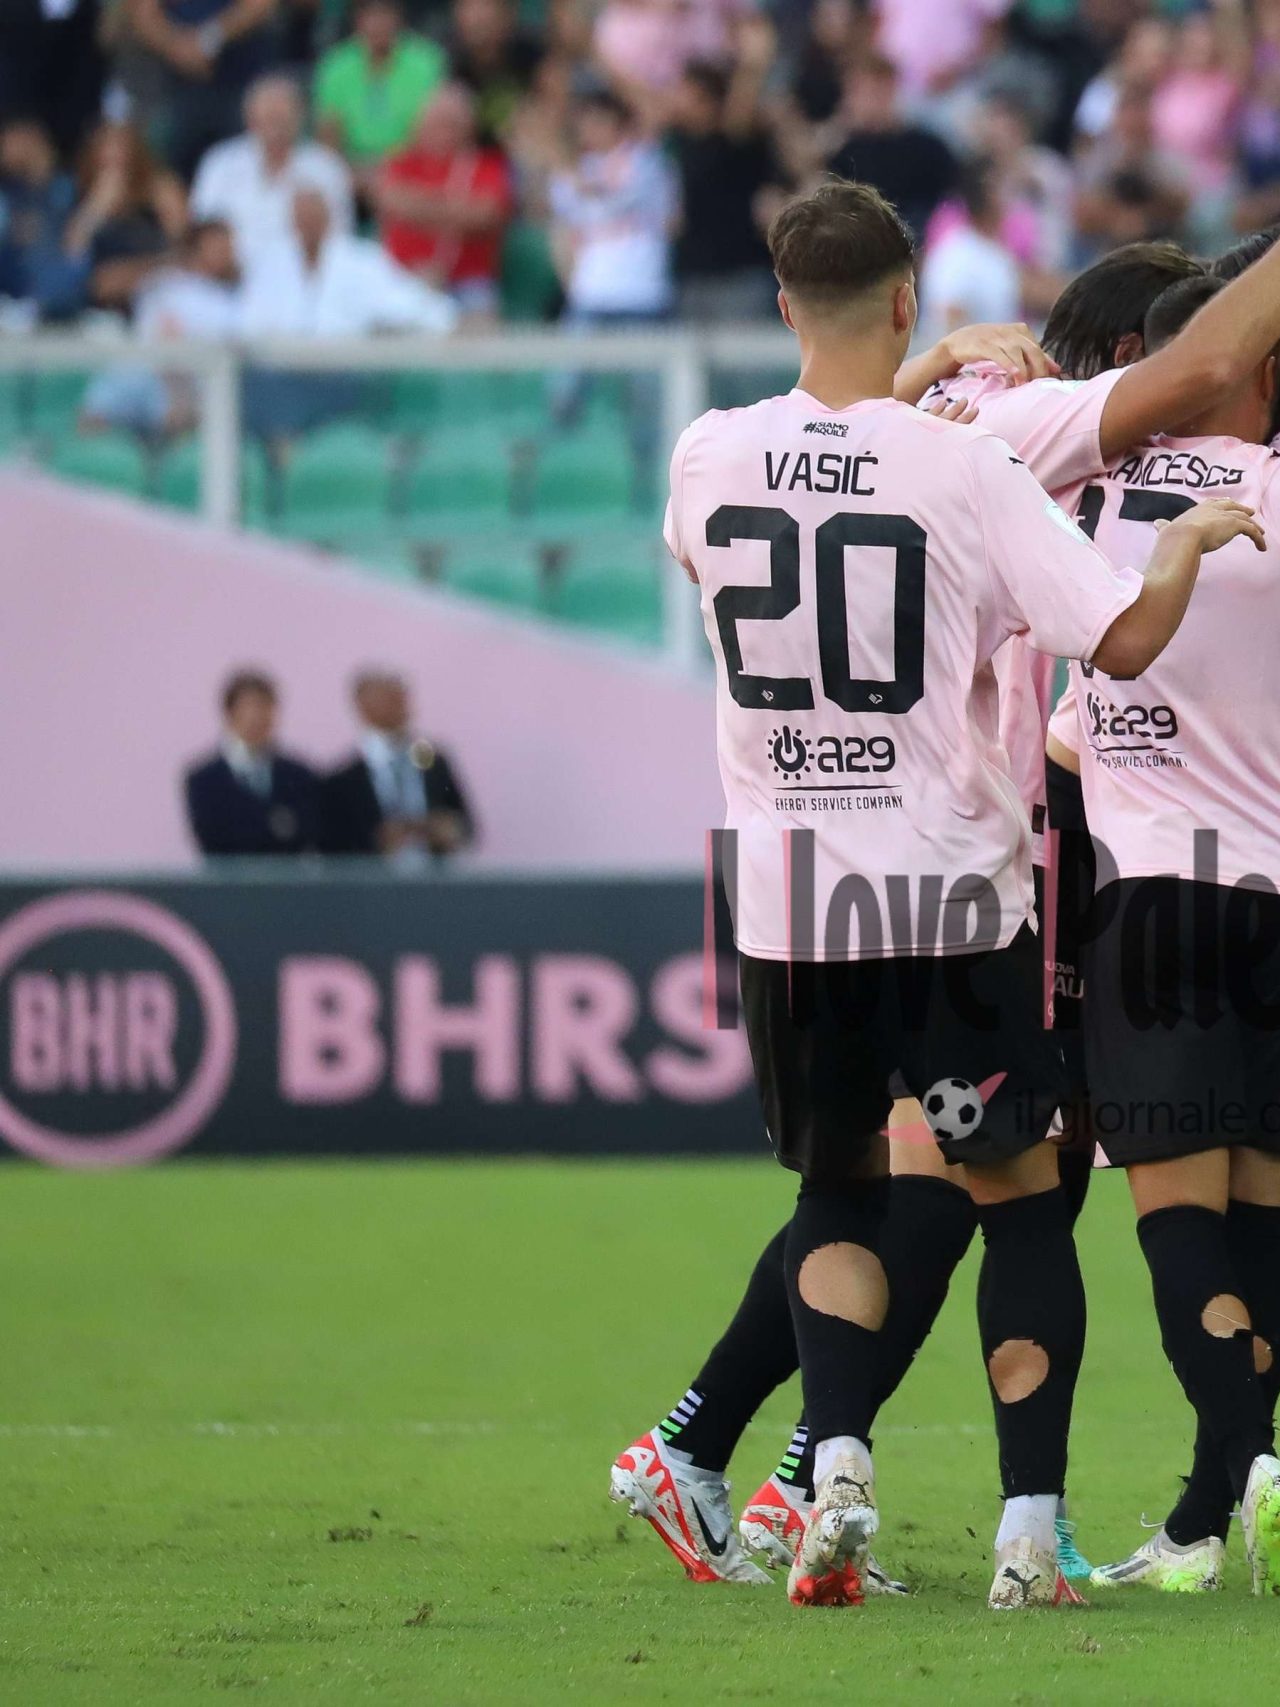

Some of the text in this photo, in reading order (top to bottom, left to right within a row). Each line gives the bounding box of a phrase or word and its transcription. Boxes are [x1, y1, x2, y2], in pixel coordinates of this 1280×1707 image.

[814, 427, 847, 438] AQUILE
[764, 450, 880, 496] VASIĆ
[1106, 452, 1246, 489] ANCESCO
[705, 504, 928, 715] 20
[817, 736, 896, 773] a29
[775, 795, 903, 811] ENERGY SERVICE COMPANY
[10, 971, 178, 1093] BHR
[277, 953, 756, 1104] BHRS
